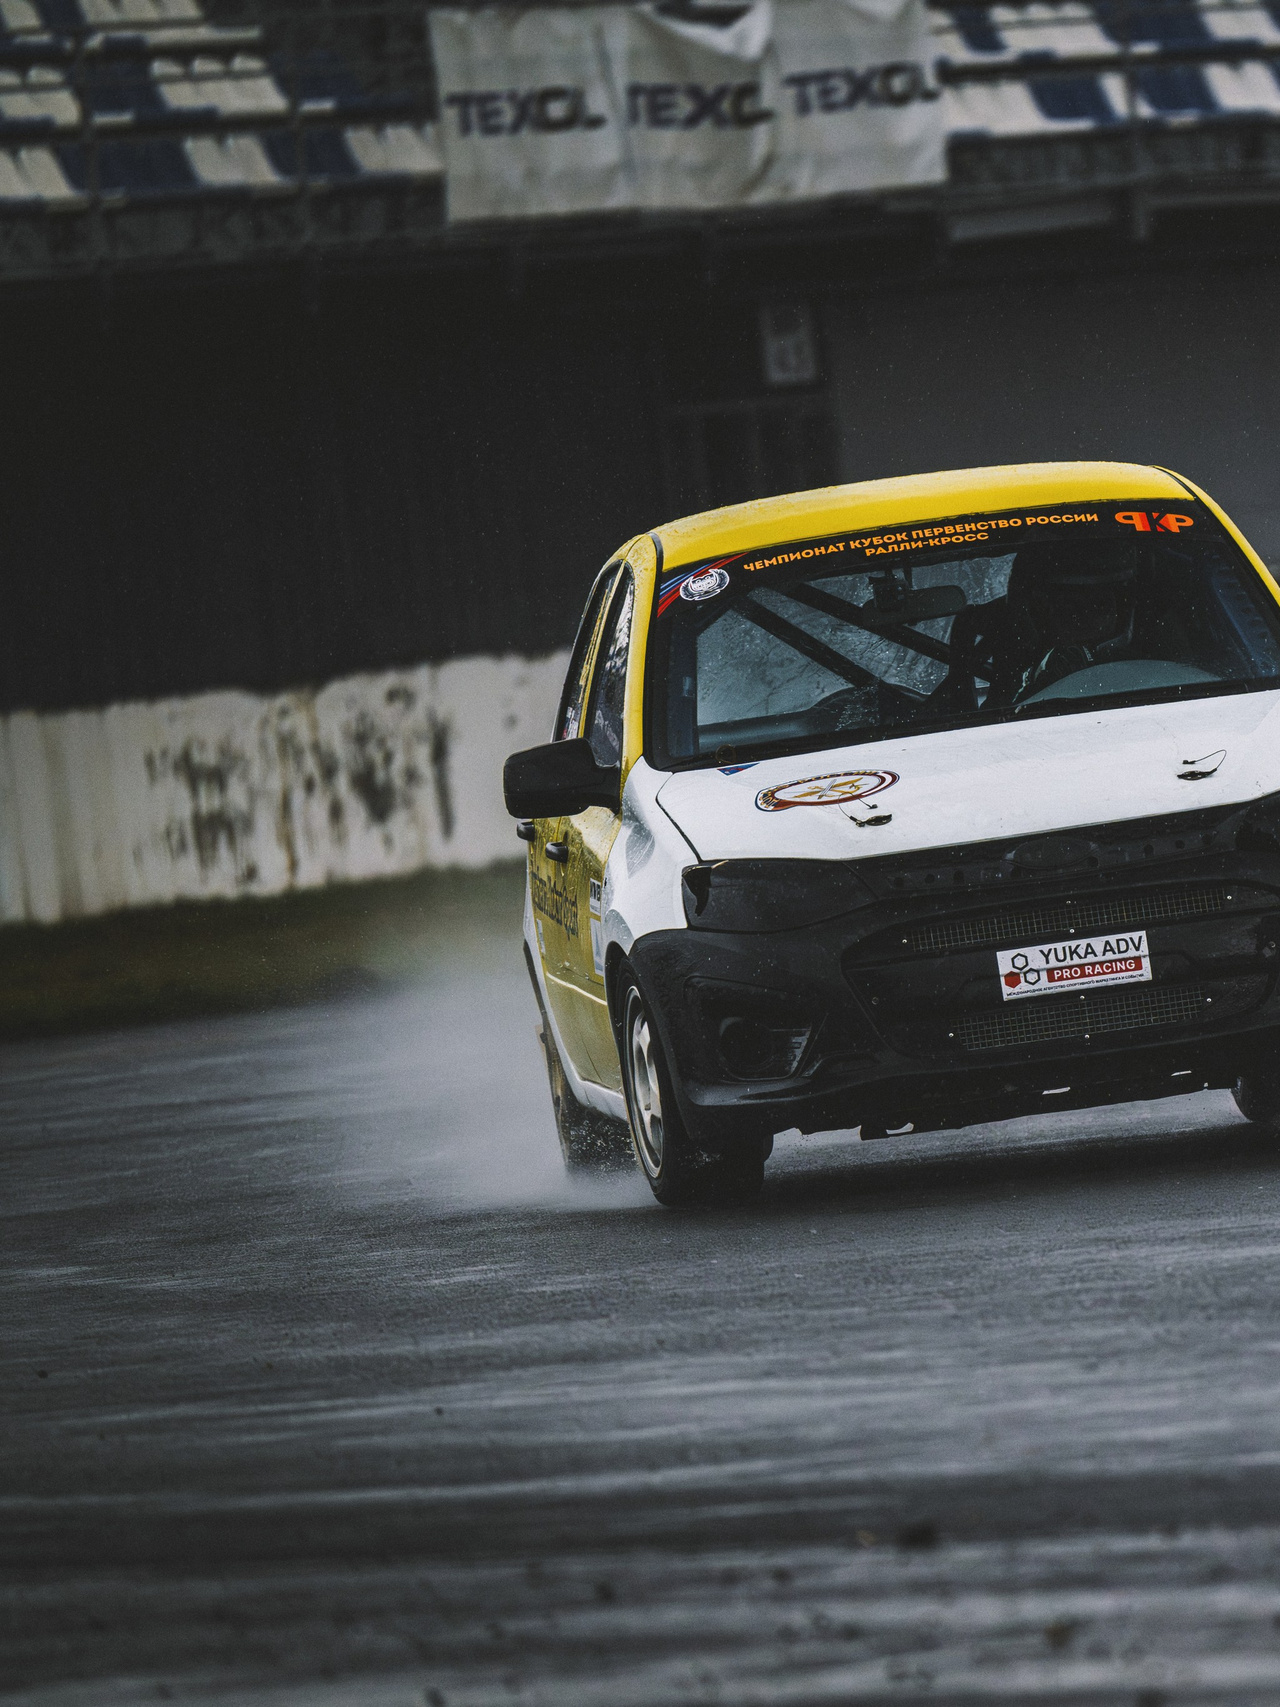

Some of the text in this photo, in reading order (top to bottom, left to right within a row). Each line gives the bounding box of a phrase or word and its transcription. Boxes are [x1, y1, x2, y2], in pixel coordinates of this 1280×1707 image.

[743, 513, 1099, 572] ЧЕМПИОНАТ КУБОК ПЕРВЕНСТВО РОССИИ
[865, 532, 990, 557] РАЛЛИ-КРОСС
[1039, 936, 1143, 965] YUKA ADV
[1053, 959, 1136, 980] PRO RACING
